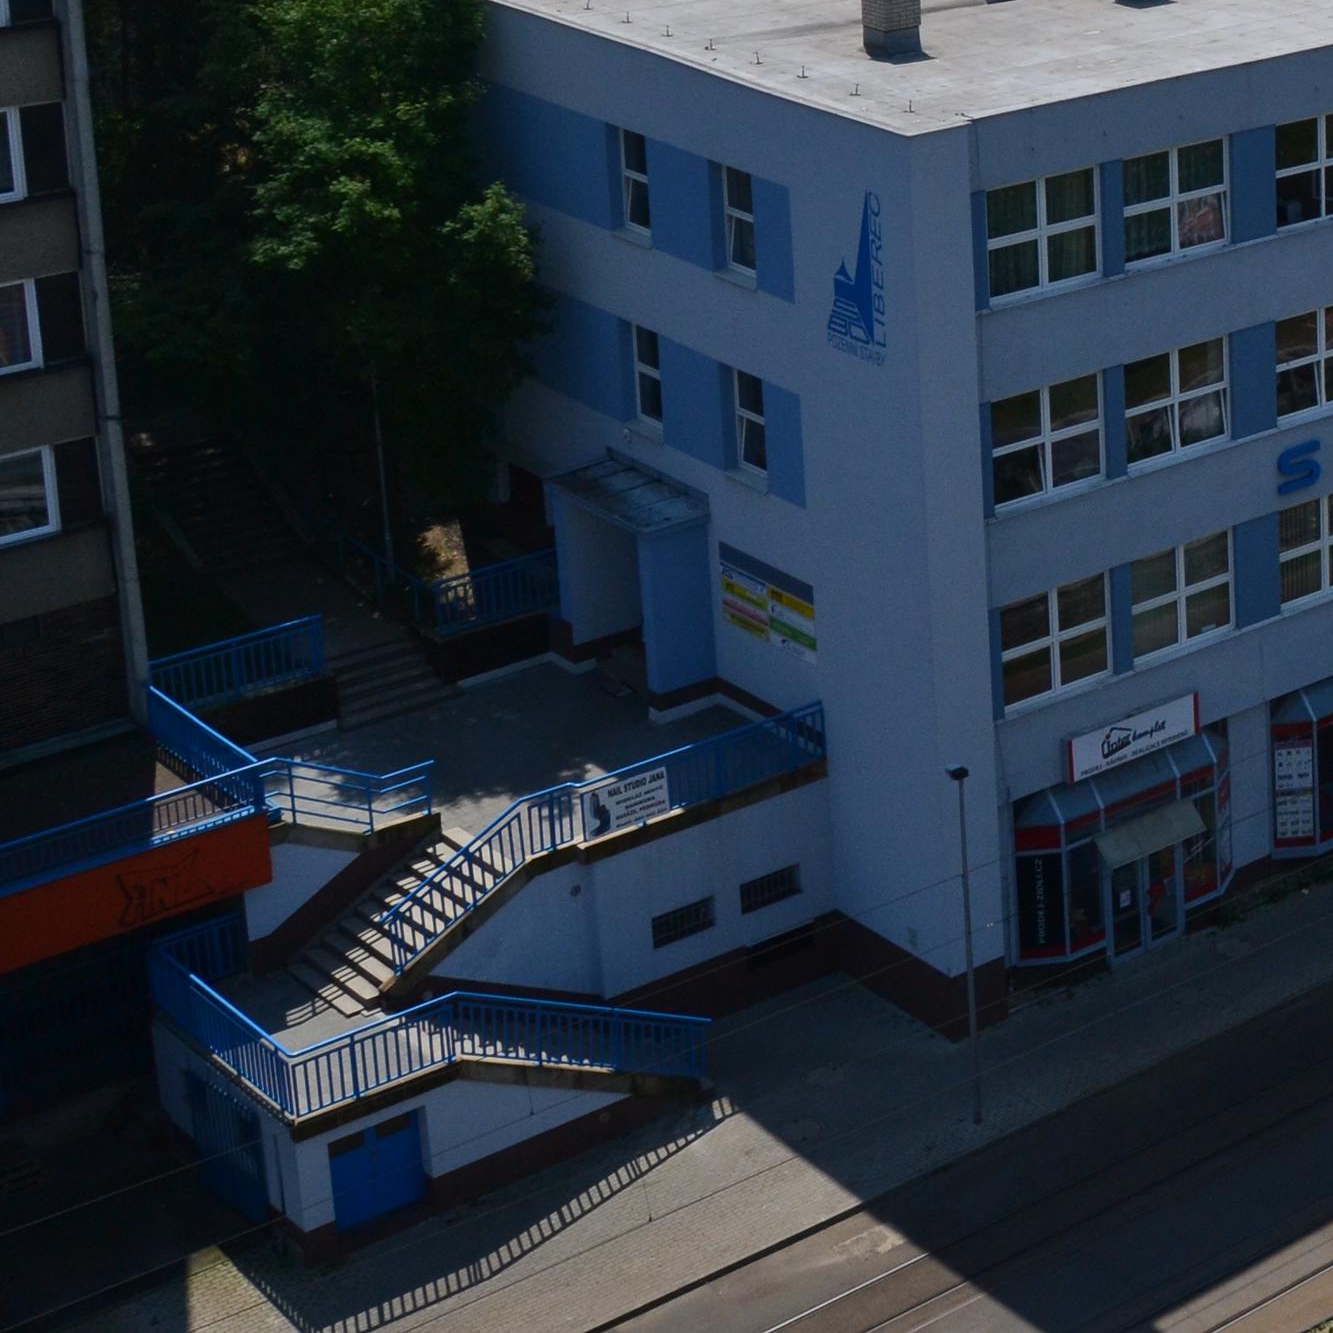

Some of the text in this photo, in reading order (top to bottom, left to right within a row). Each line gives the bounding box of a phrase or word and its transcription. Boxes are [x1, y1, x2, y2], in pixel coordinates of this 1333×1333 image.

[868, 191, 887, 348] LIBEREC
[607, 770, 665, 798] NAIL STUDIO JANA
